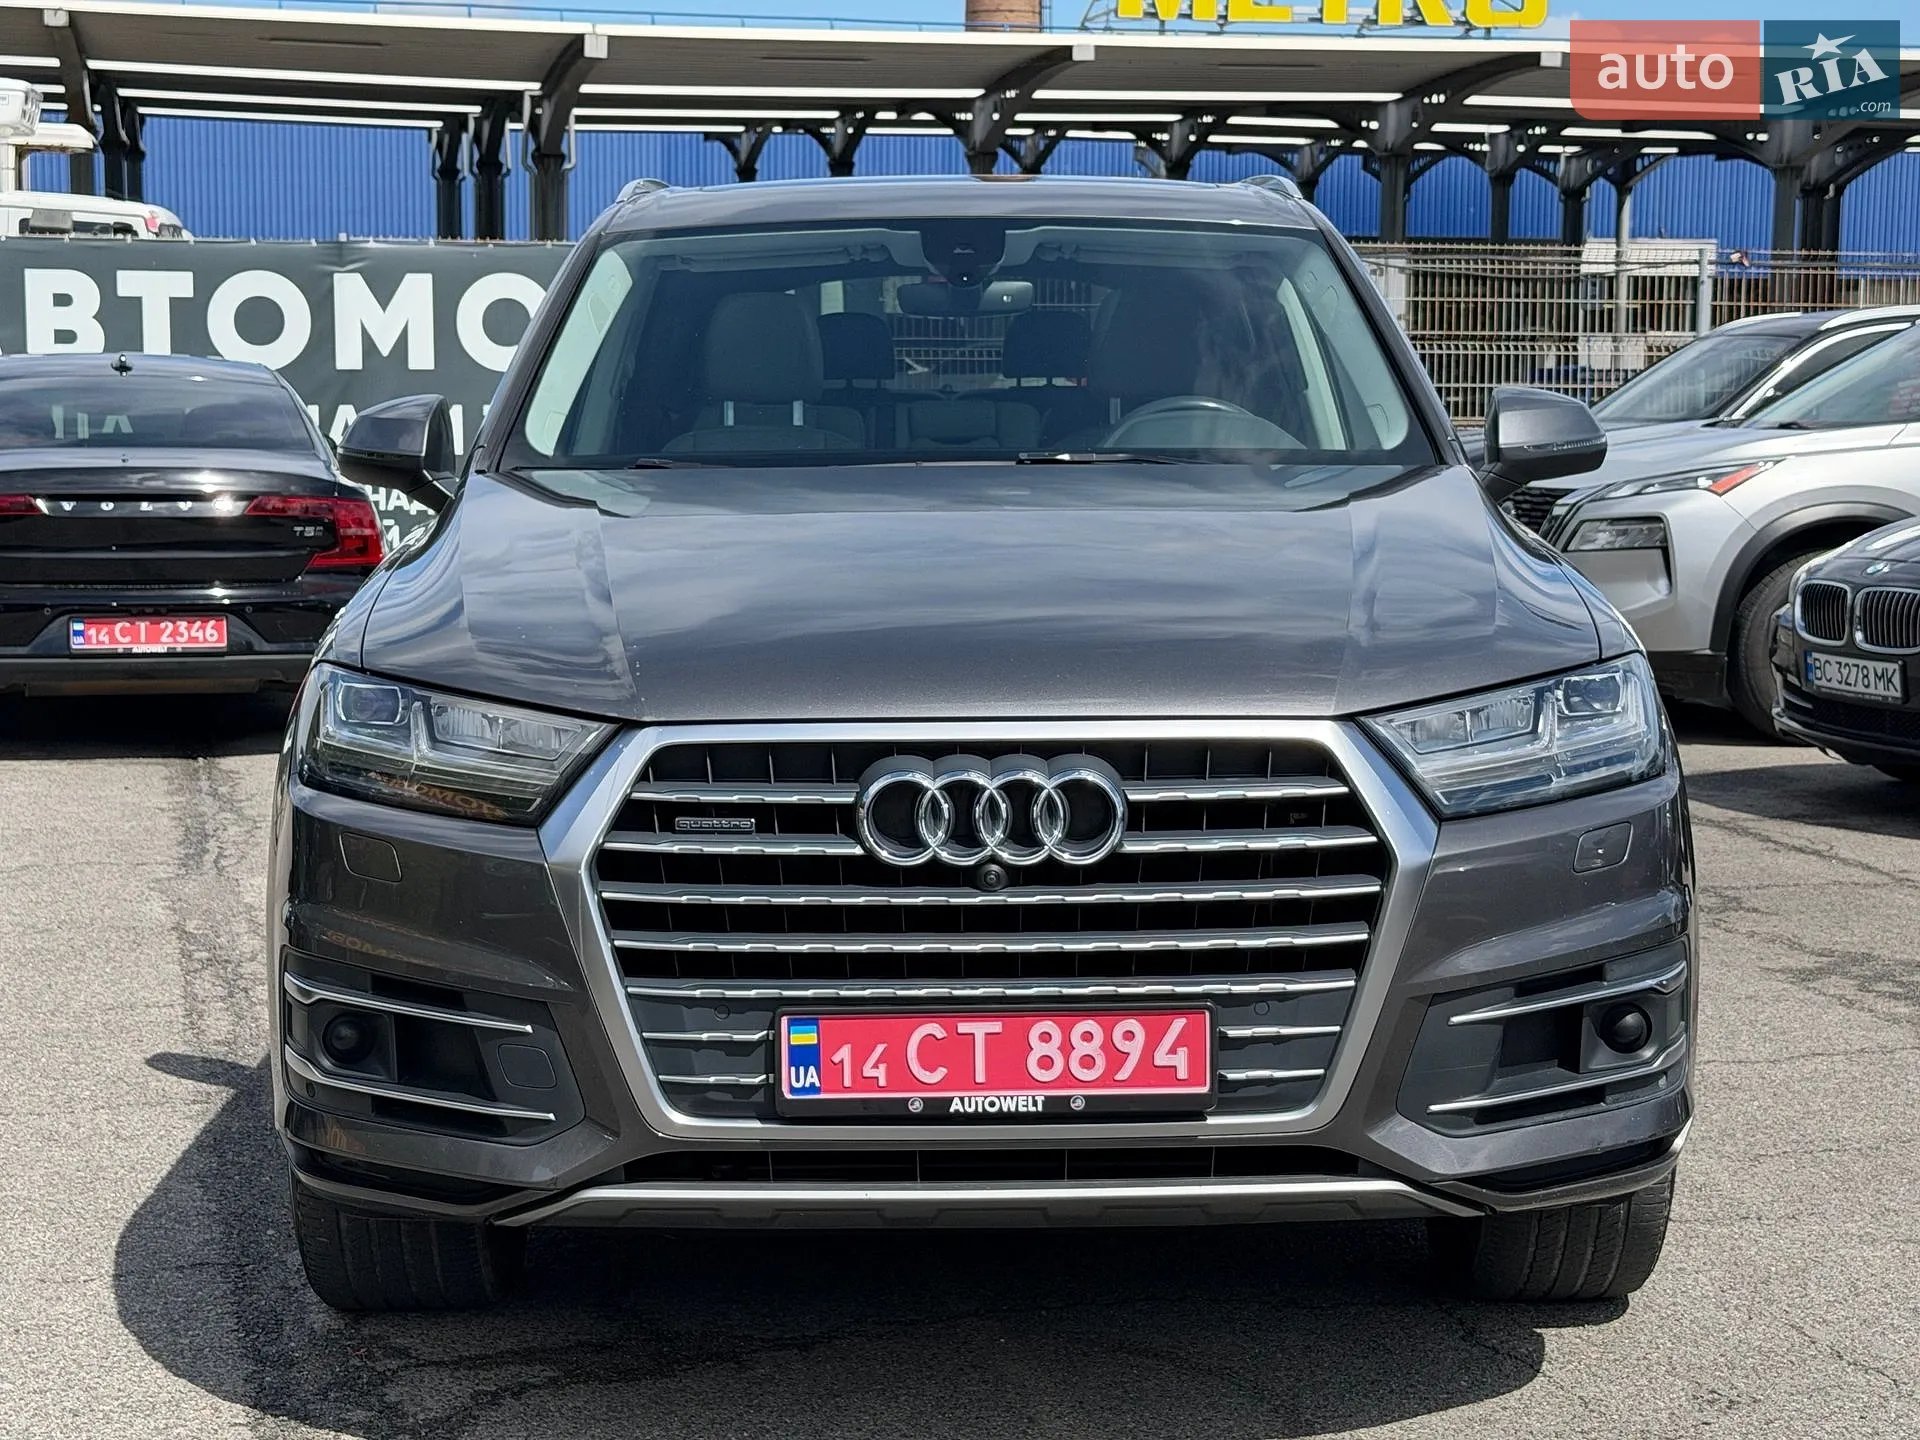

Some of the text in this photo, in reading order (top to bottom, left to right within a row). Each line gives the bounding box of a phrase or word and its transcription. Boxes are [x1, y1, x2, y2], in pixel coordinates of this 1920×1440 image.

[0, 268, 547, 373] ВТОМО
[87, 619, 219, 645] 14 CT 2346
[1813, 658, 1899, 693] BC 3278 MK
[677, 819, 752, 830] quattro
[830, 1017, 1190, 1088] 14 CT 8894
[790, 1065, 821, 1088] UA
[949, 1095, 1045, 1113] AUTOWELT
